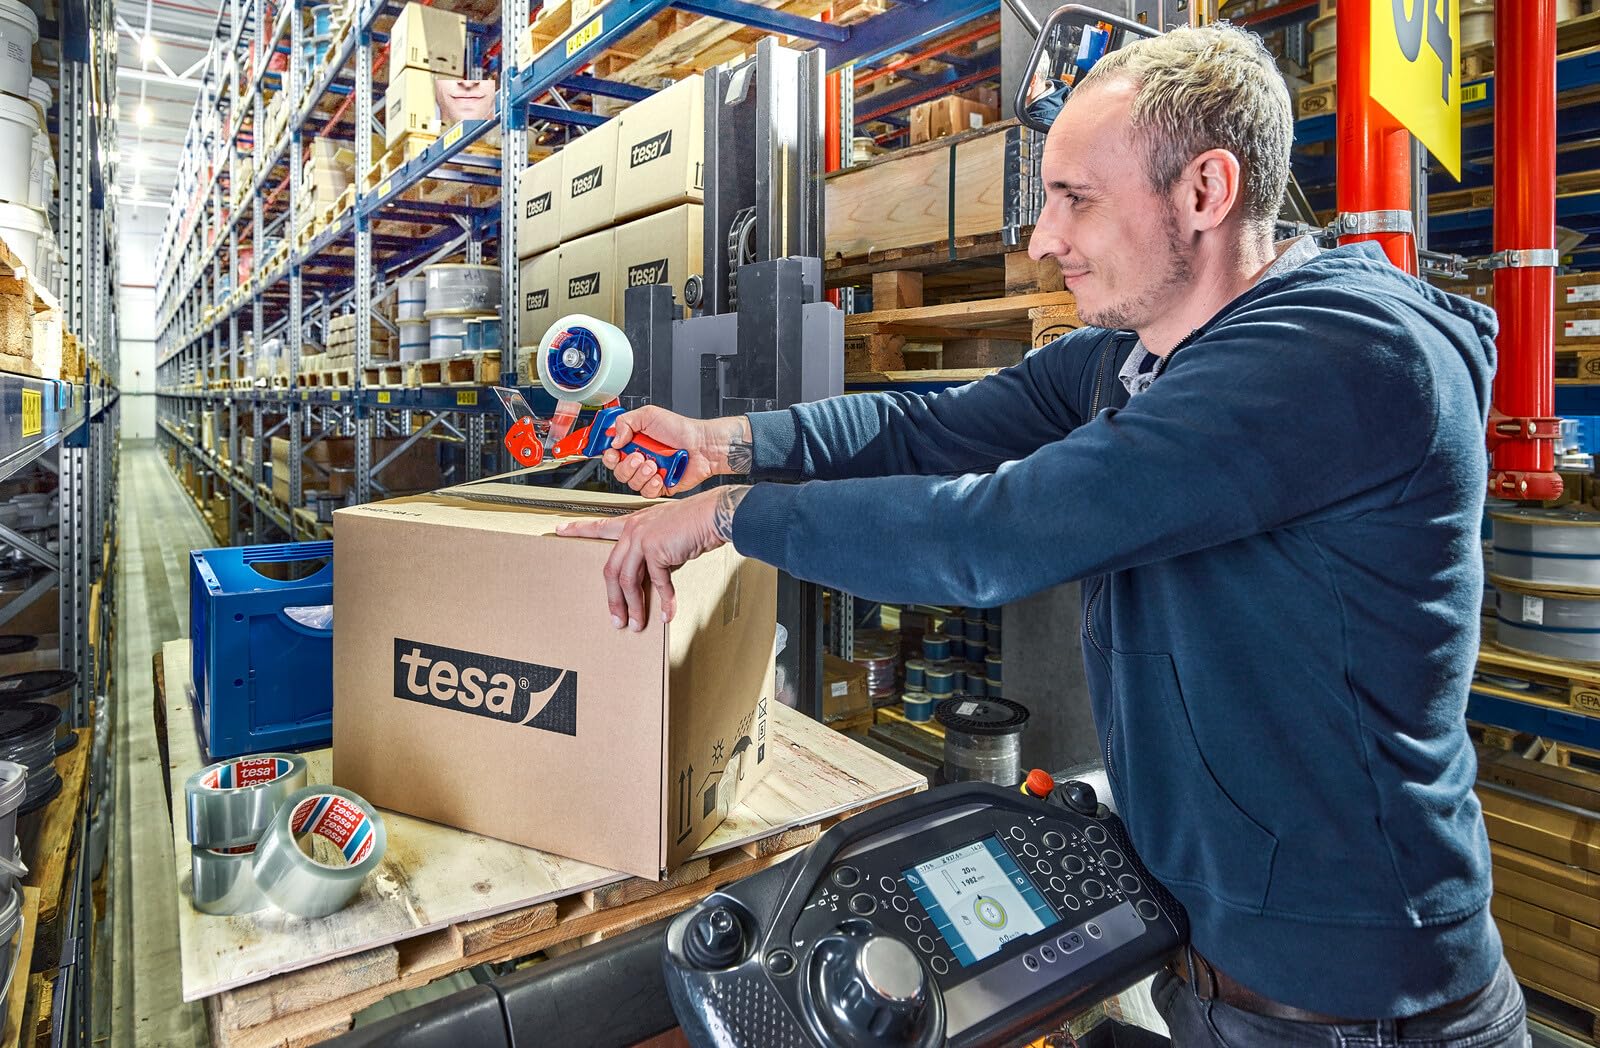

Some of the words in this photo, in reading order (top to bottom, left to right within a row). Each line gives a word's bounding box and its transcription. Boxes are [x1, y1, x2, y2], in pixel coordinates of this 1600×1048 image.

[632, 141, 660, 165] tesa
[572, 174, 594, 196] tesa
[630, 267, 656, 287] tesa
[570, 279, 591, 297] tesa
[1580, 695, 1600, 707] EPA
[240, 766, 271, 778] tesa
[328, 811, 352, 829] tesa
[333, 804, 357, 822] tesa
[319, 825, 343, 843] tesa
[323, 818, 347, 836] tesa
